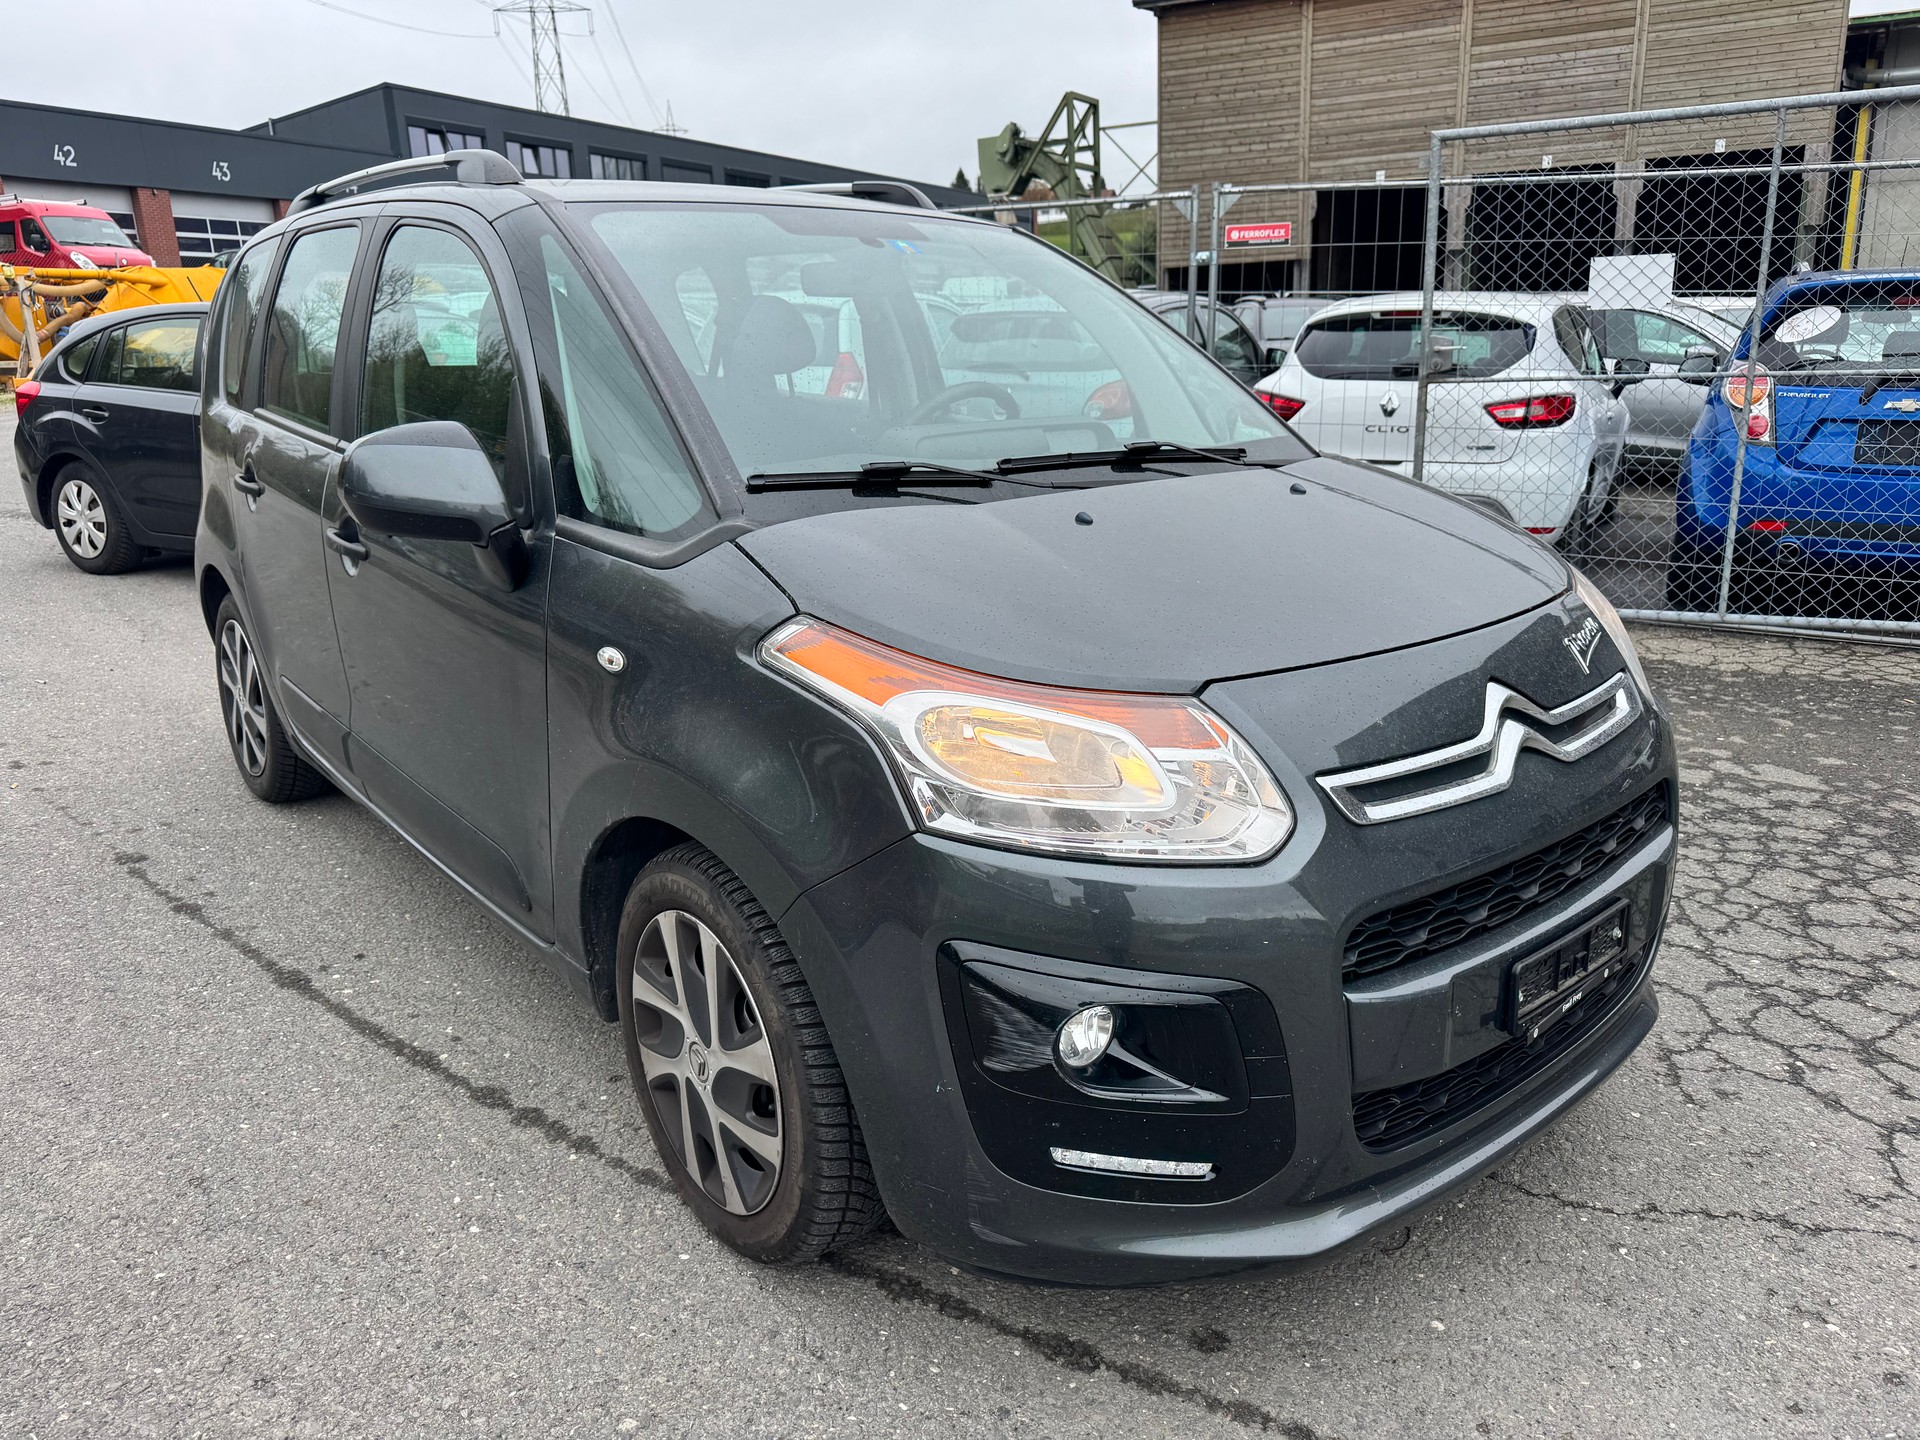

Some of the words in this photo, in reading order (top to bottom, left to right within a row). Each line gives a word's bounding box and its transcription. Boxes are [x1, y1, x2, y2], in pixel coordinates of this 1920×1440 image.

[53, 144, 78, 167] 42
[211, 161, 231, 182] 43
[1240, 228, 1286, 239] FERROFLEX
[1778, 391, 1831, 399] CHEVROLET
[1365, 425, 1410, 434] CLIO
